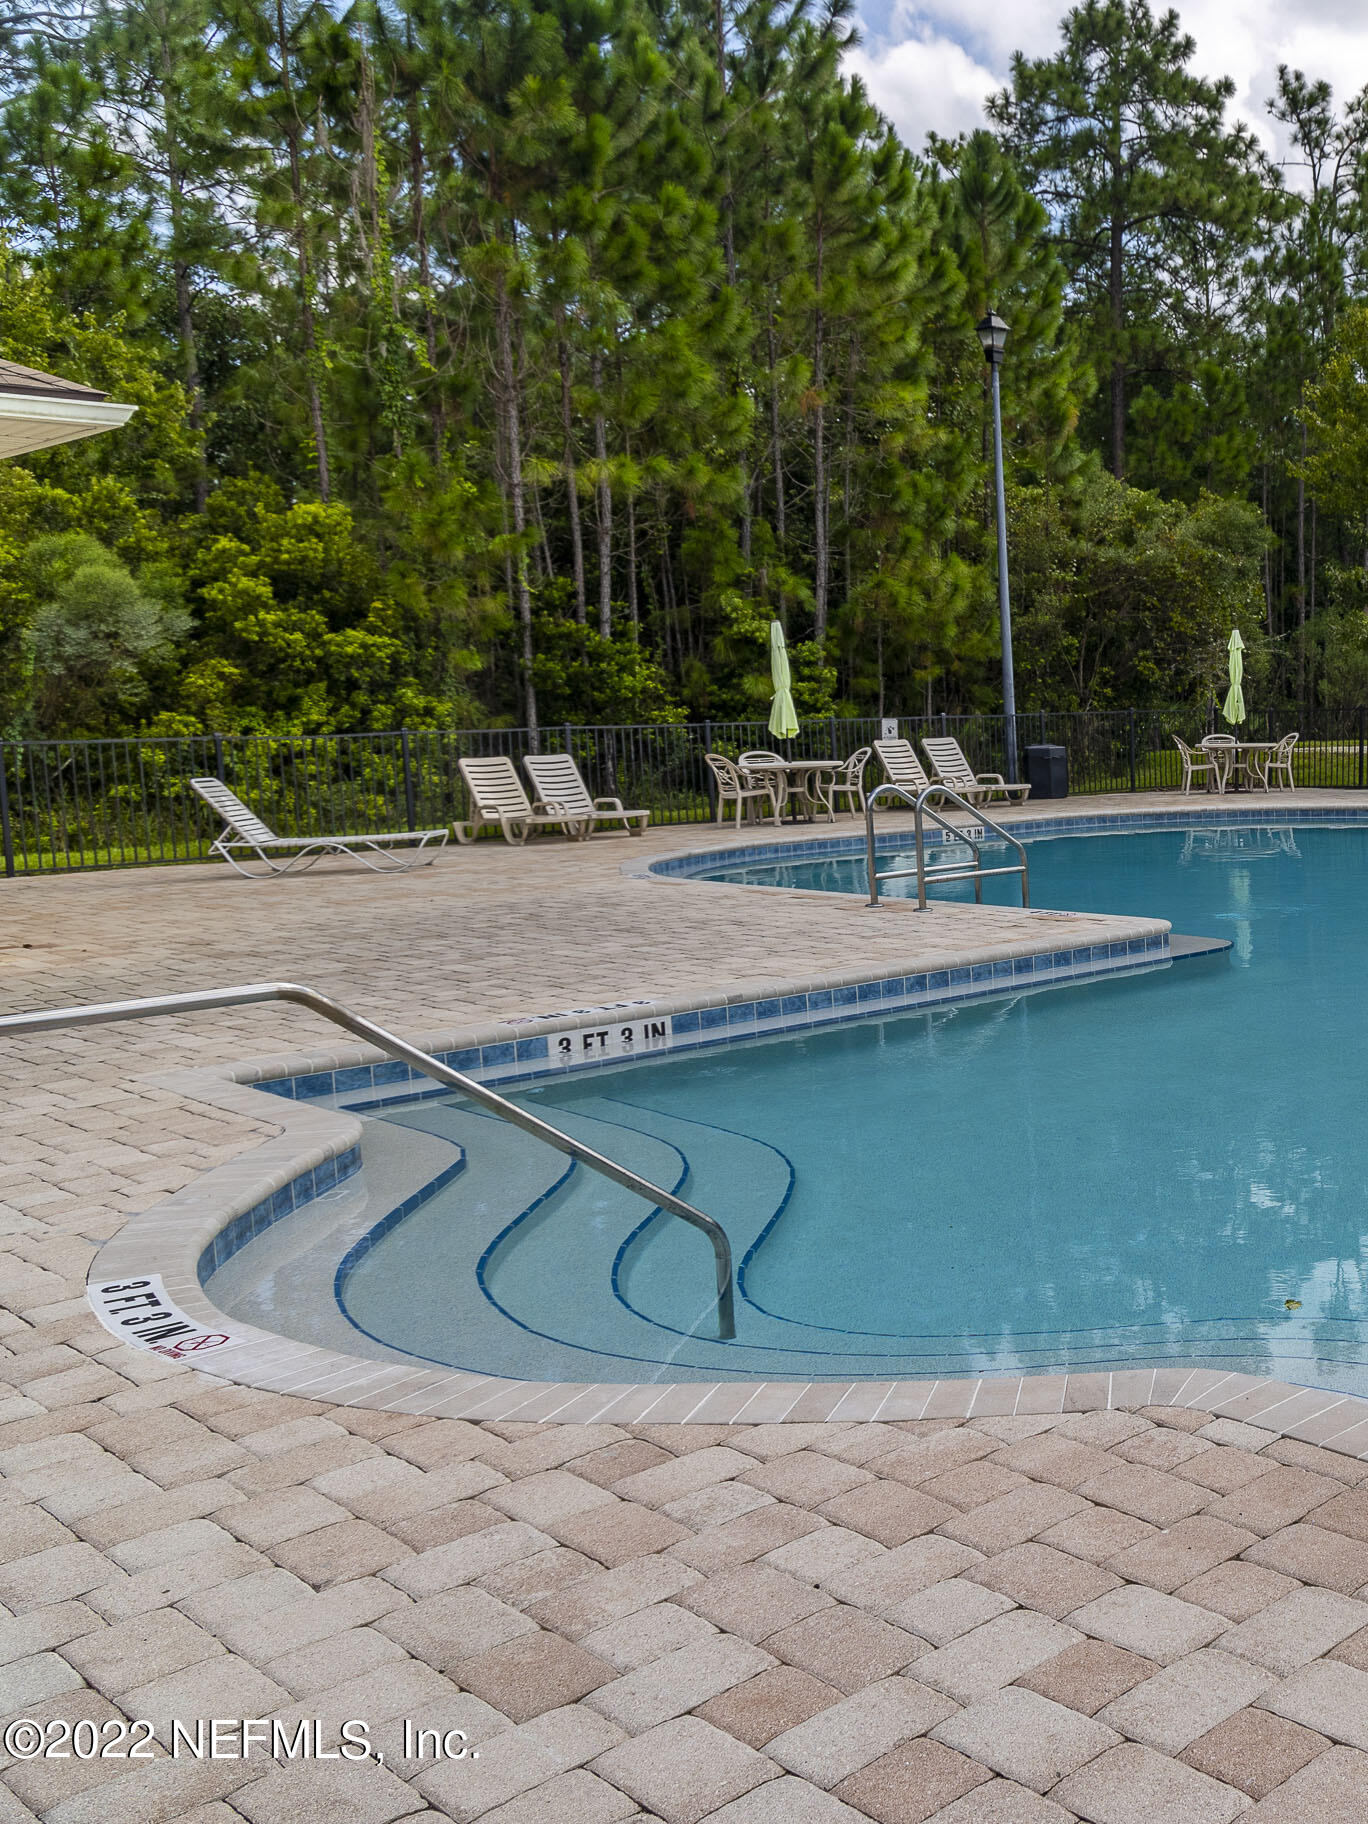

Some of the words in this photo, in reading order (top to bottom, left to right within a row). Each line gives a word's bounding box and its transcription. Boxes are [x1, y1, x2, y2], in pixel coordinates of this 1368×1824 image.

[557, 1036, 572, 1054] 3
[582, 1030, 609, 1050] FT
[620, 1027, 634, 1043] 3
[643, 1021, 666, 1040] IN
[101, 1280, 151, 1294] 3
[103, 1292, 162, 1316] FT.
[120, 1311, 173, 1326] 3
[131, 1321, 198, 1345] IN.
